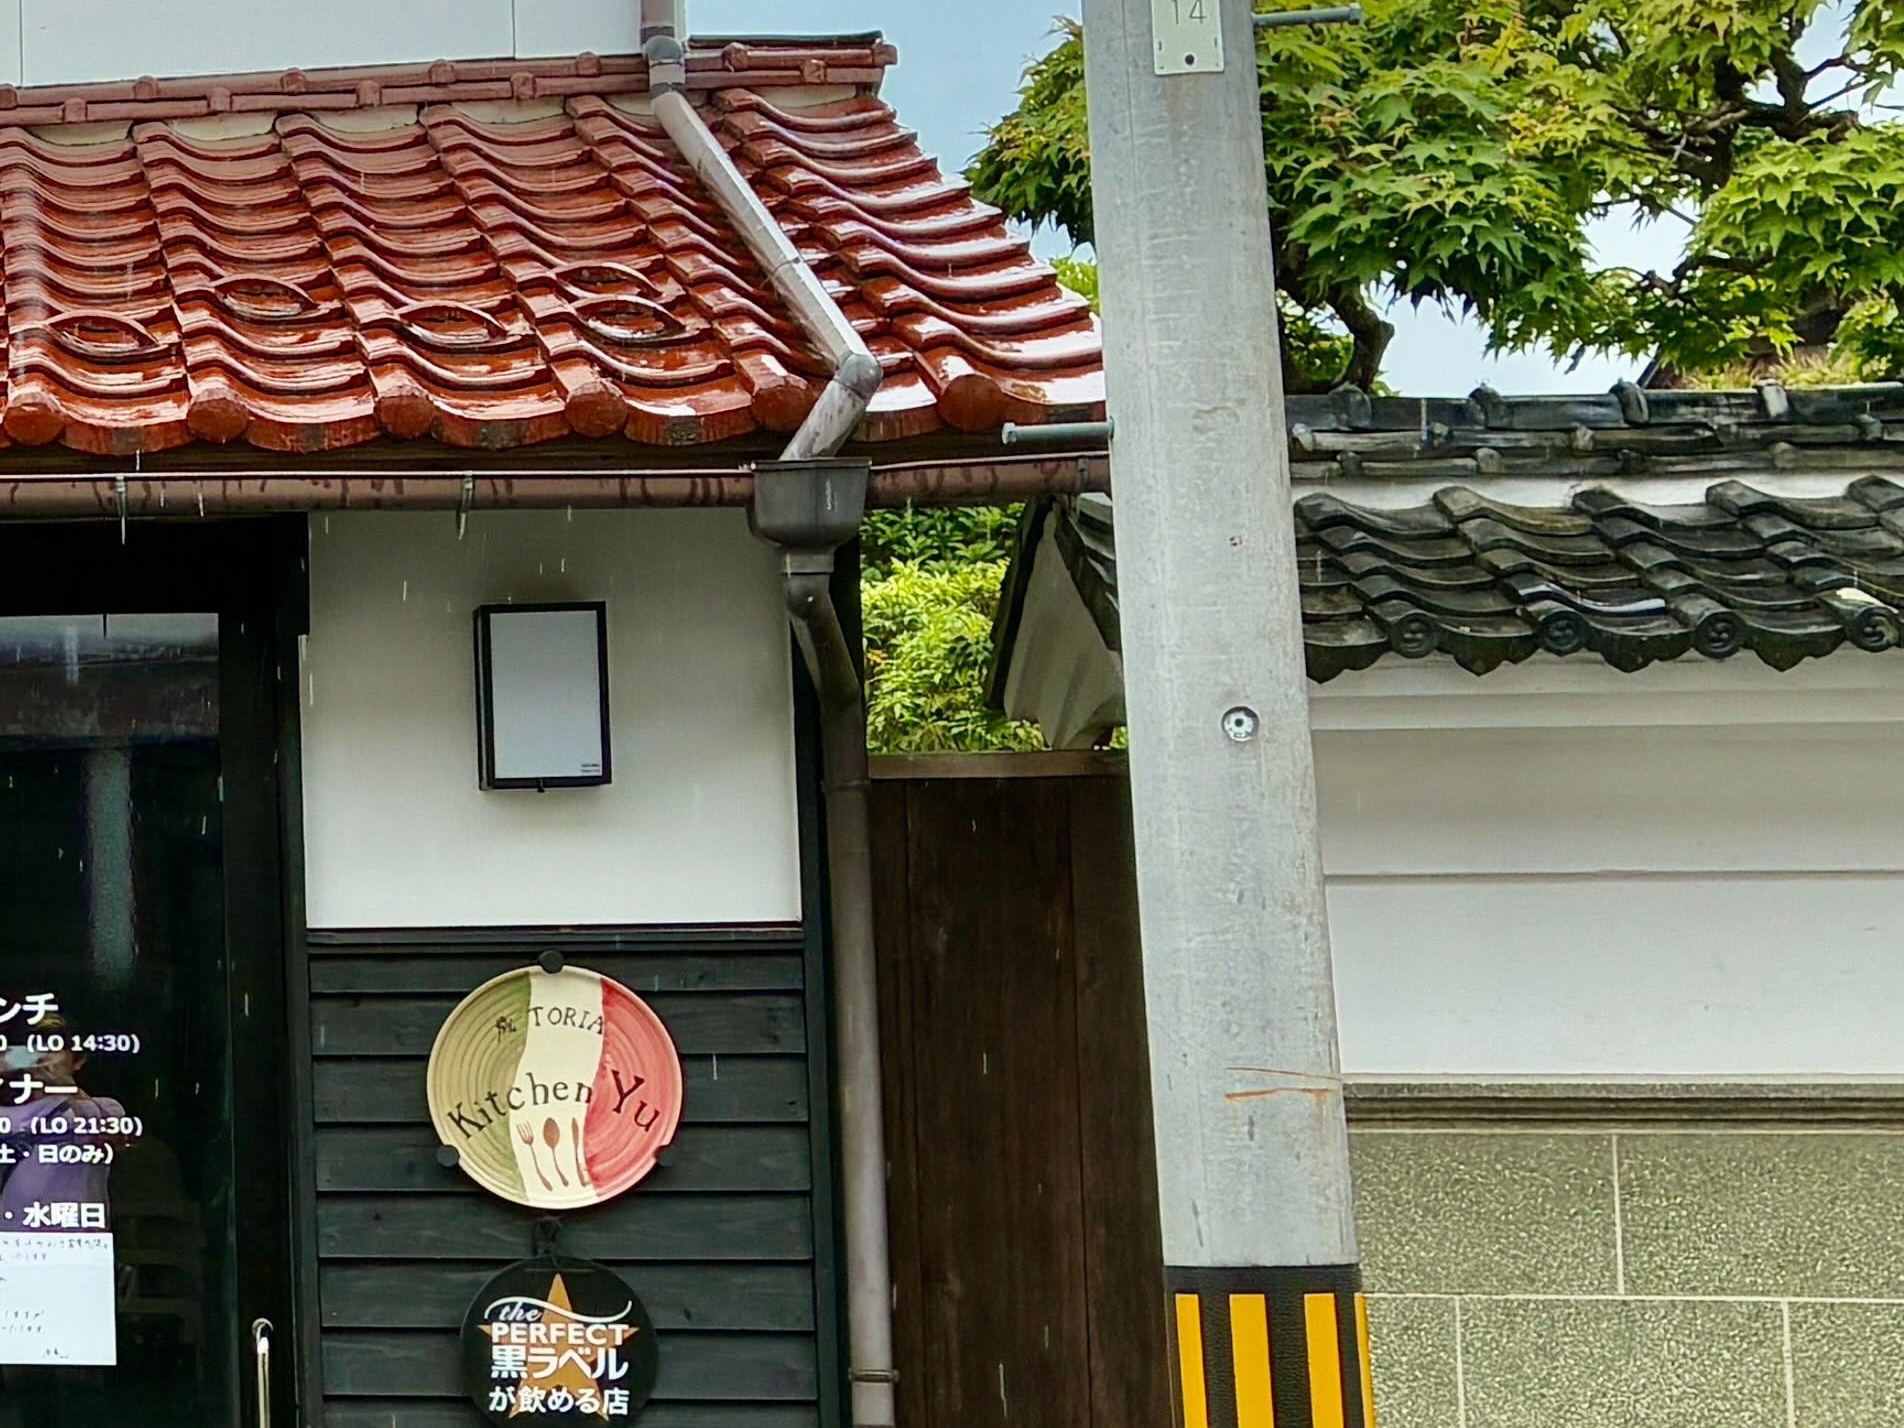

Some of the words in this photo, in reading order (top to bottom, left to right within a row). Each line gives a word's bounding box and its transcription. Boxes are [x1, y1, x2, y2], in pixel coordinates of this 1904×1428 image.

[528, 1006, 604, 1036] TORIA
[27, 1033, 65, 1054] (LO
[71, 1033, 141, 1054] 14:30)
[447, 1071, 593, 1140] Kitchen
[610, 1068, 661, 1132] Yu
[30, 1115, 68, 1136] (LO
[74, 1115, 144, 1136] 21:30)
[498, 1301, 543, 1323] the
[491, 1323, 629, 1346] PERFECT
[490, 1344, 629, 1381] 黒ラベル
[488, 1386, 630, 1416] が飲める店
